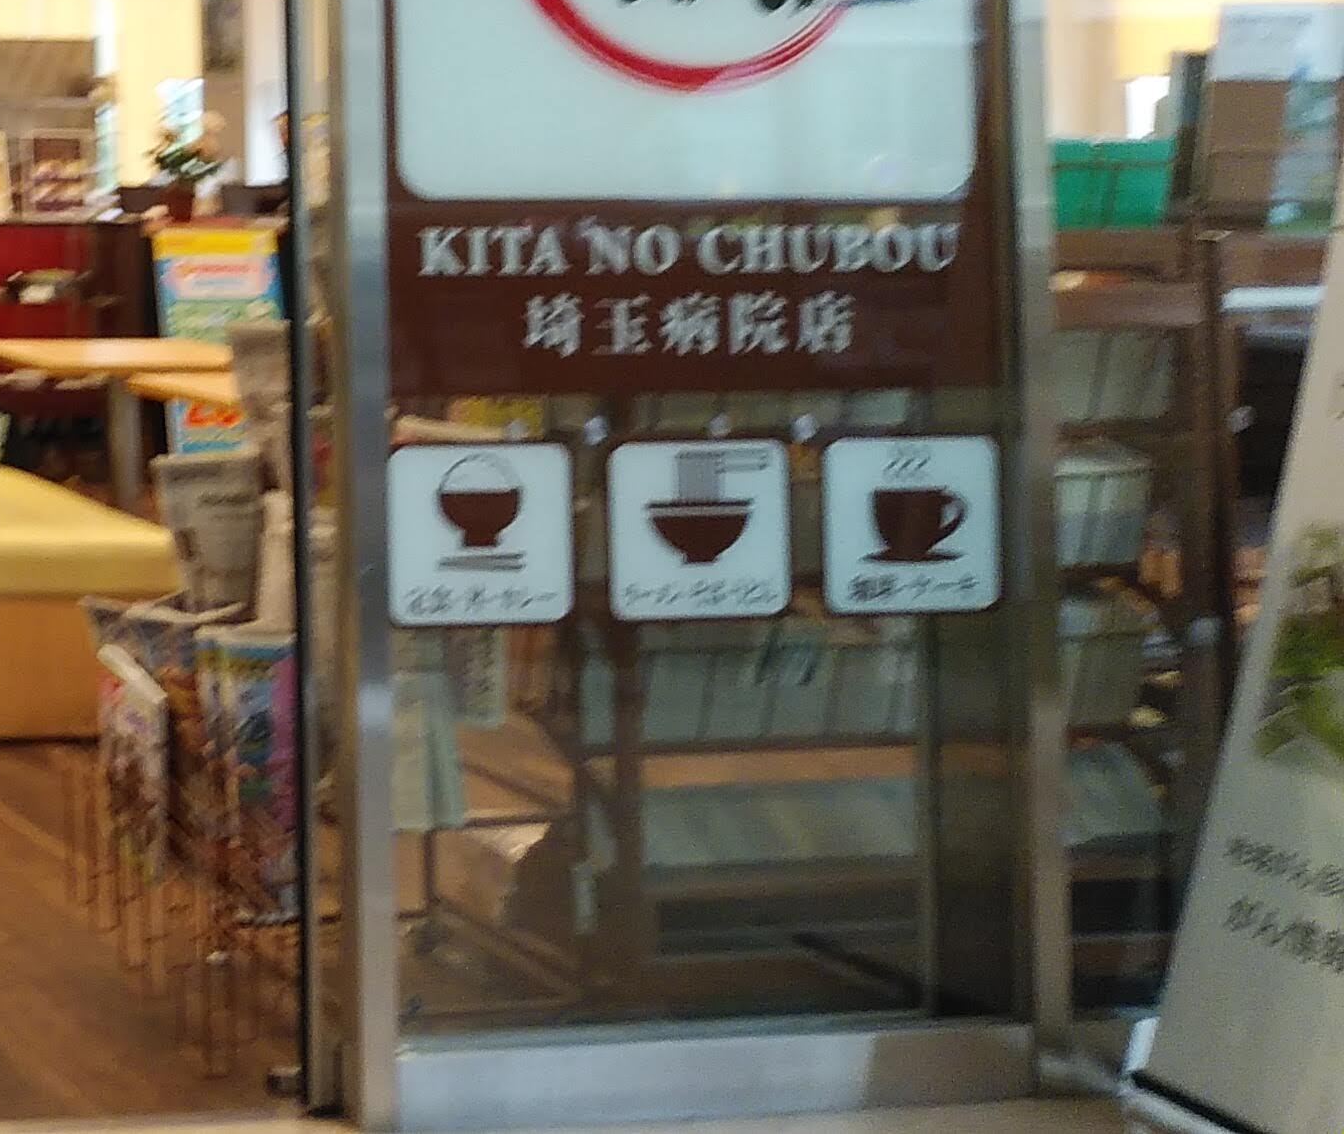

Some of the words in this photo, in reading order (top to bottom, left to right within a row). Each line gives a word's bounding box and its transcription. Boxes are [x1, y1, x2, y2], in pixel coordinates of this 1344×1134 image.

[416, 222, 570, 277] KITA
[582, 218, 683, 277] NO
[697, 221, 963, 276] CHUBOU
[522, 288, 858, 358] 埼玉病院店
